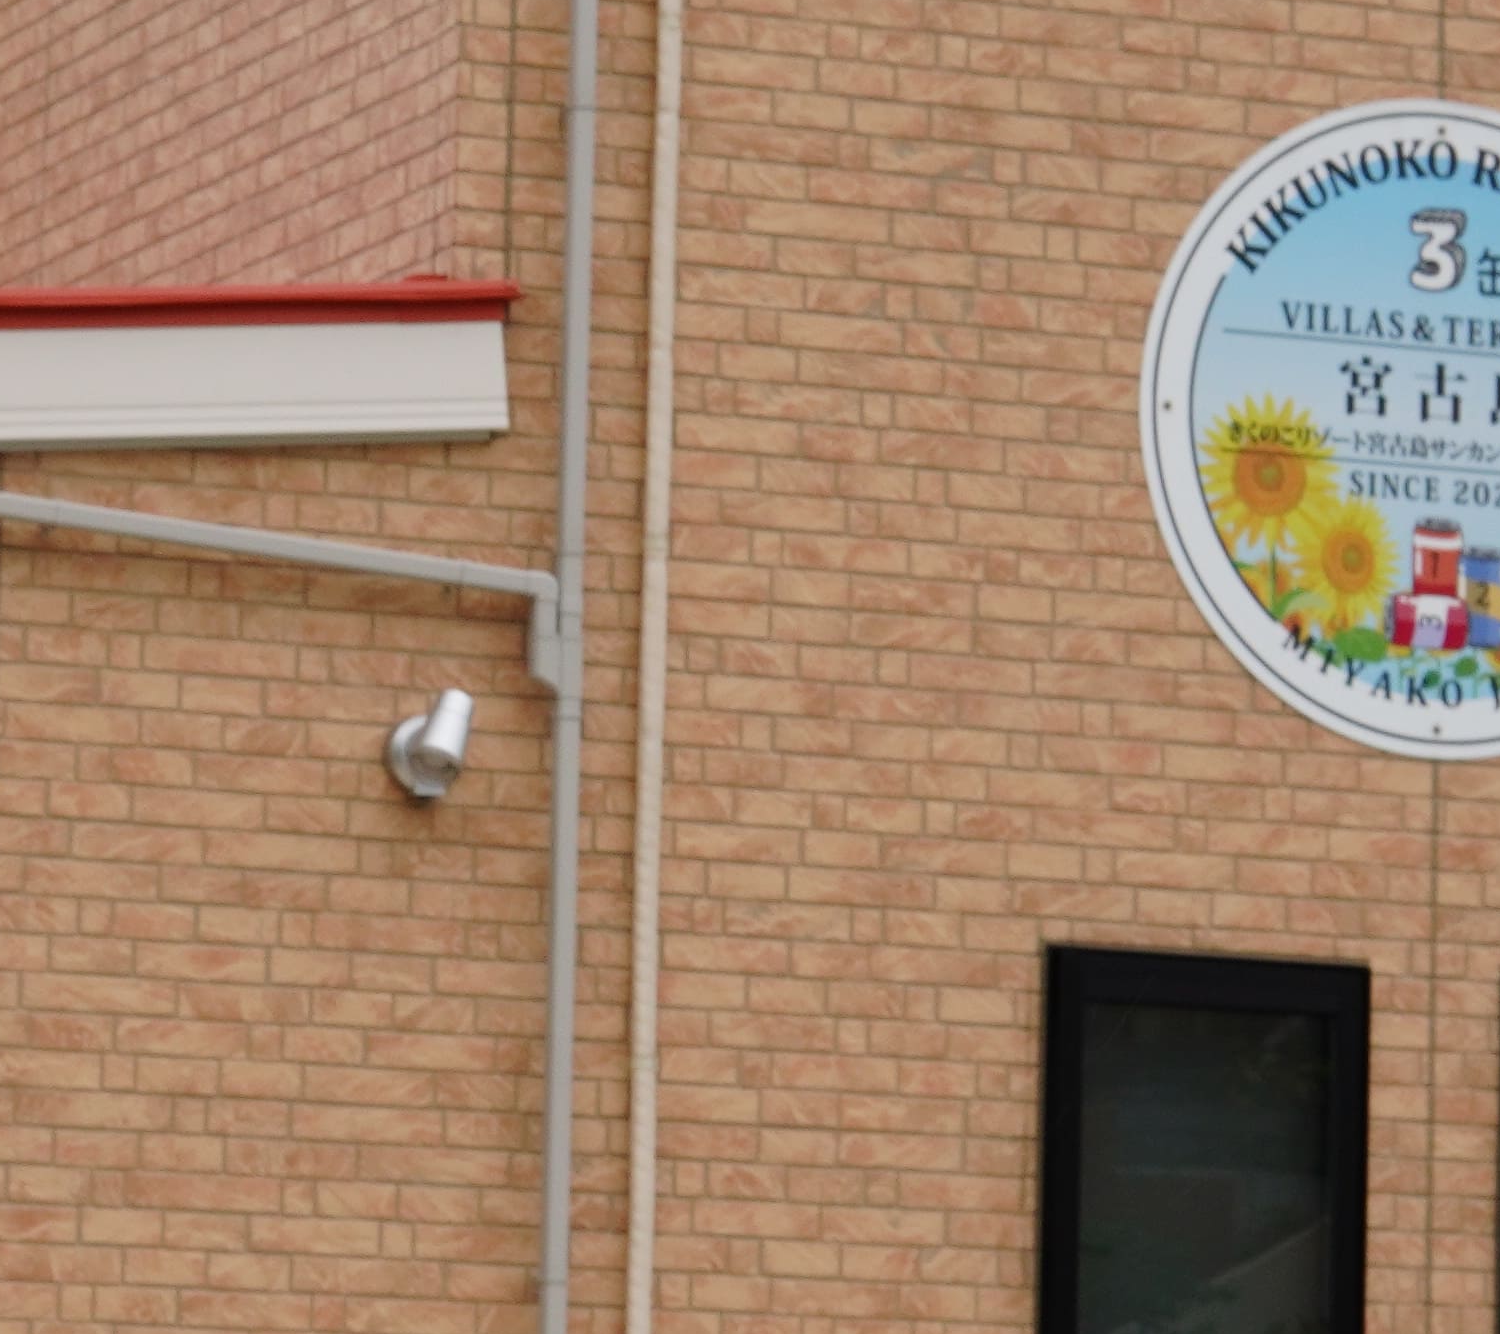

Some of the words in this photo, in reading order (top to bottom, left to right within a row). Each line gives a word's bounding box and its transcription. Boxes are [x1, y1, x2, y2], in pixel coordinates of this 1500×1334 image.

[1225, 139, 1459, 274] KIKUNOKO
[1281, 300, 1405, 341] VILLAS
[1349, 470, 1440, 503] SINCE
[1283, 623, 1463, 707] MIYAKO
